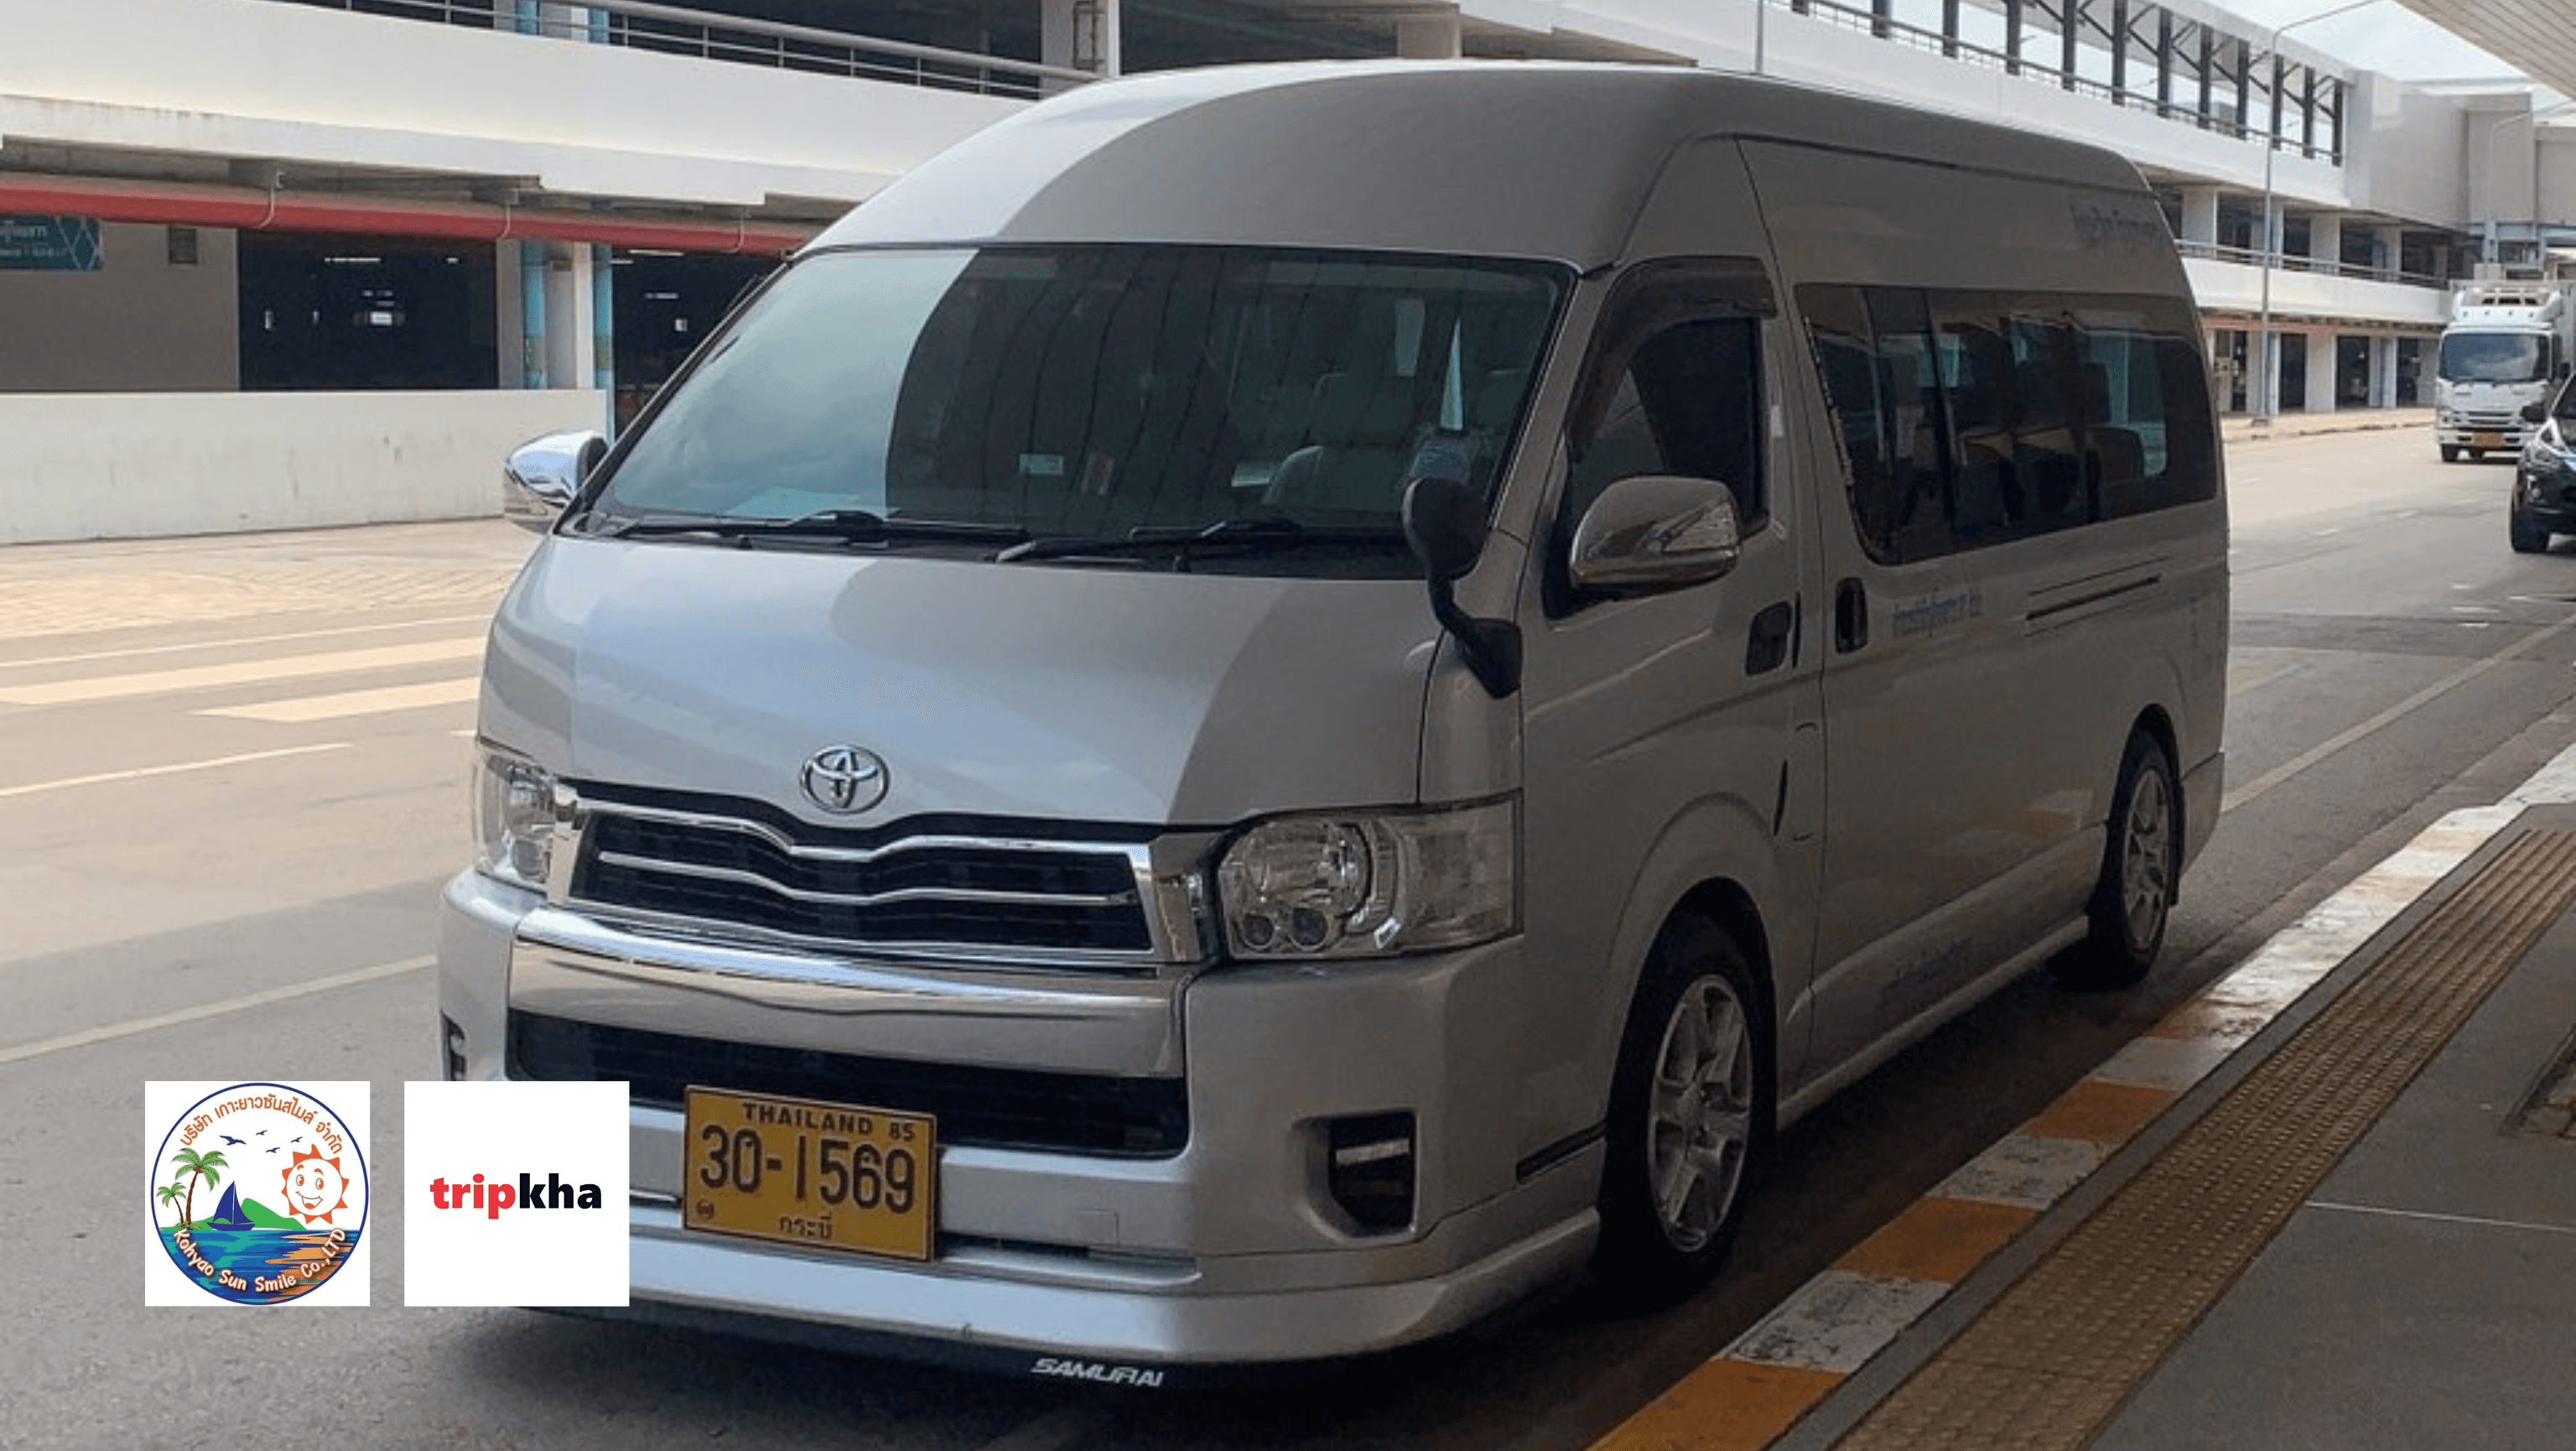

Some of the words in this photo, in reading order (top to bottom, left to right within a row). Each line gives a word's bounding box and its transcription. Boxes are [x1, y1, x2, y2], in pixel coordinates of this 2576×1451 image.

[743, 1103, 873, 1136] THAILAND
[889, 1121, 916, 1142] 85
[700, 1125, 916, 1214] 30-1569
[1031, 1358, 1164, 1387] SAMURAI
